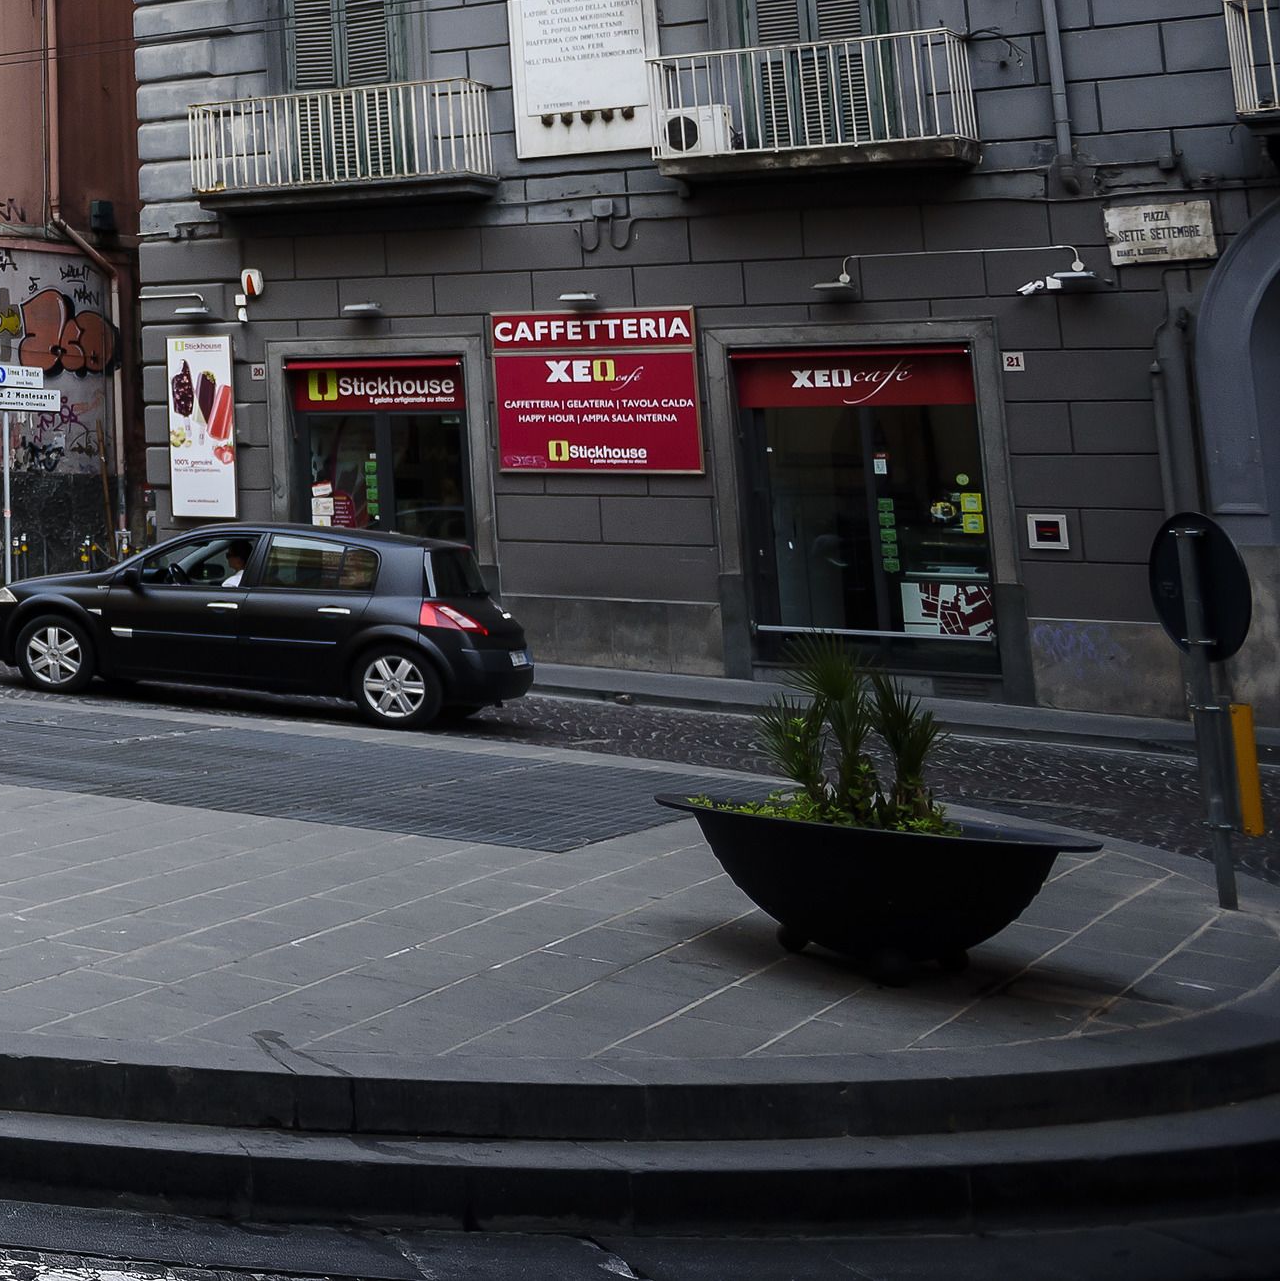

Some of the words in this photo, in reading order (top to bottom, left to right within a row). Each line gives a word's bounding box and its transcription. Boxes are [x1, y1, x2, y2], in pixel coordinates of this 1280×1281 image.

[585, 3, 607, 11] DELLA
[551, 25, 577, 35] POPOLO
[613, 29, 639, 38] SPIRITO
[1143, 211, 1170, 222] PIAZZA
[1119, 228, 1146, 243] SETTE
[1150, 225, 1201, 241] SETTEMBRE
[494, 317, 690, 342] CAFFETTERIA
[184, 342, 222, 350] Stickhouse
[1006, 356, 1022, 368] 21
[253, 367, 264, 376] 20
[339, 376, 455, 396] Stickhouse
[504, 400, 560, 409] CAFFETTERIA
[567, 399, 614, 409] GELATERIA
[621, 399, 658, 408] TAVOLA
[661, 398, 694, 408] CALDA
[518, 414, 546, 423] HAPPY
[548, 414, 575, 423] HOUR
[582, 414, 610, 423] AMPIA
[611, 413, 634, 423] SALA
[636, 413, 678, 423] INTERNA
[569, 444, 647, 459] Stickhouse
